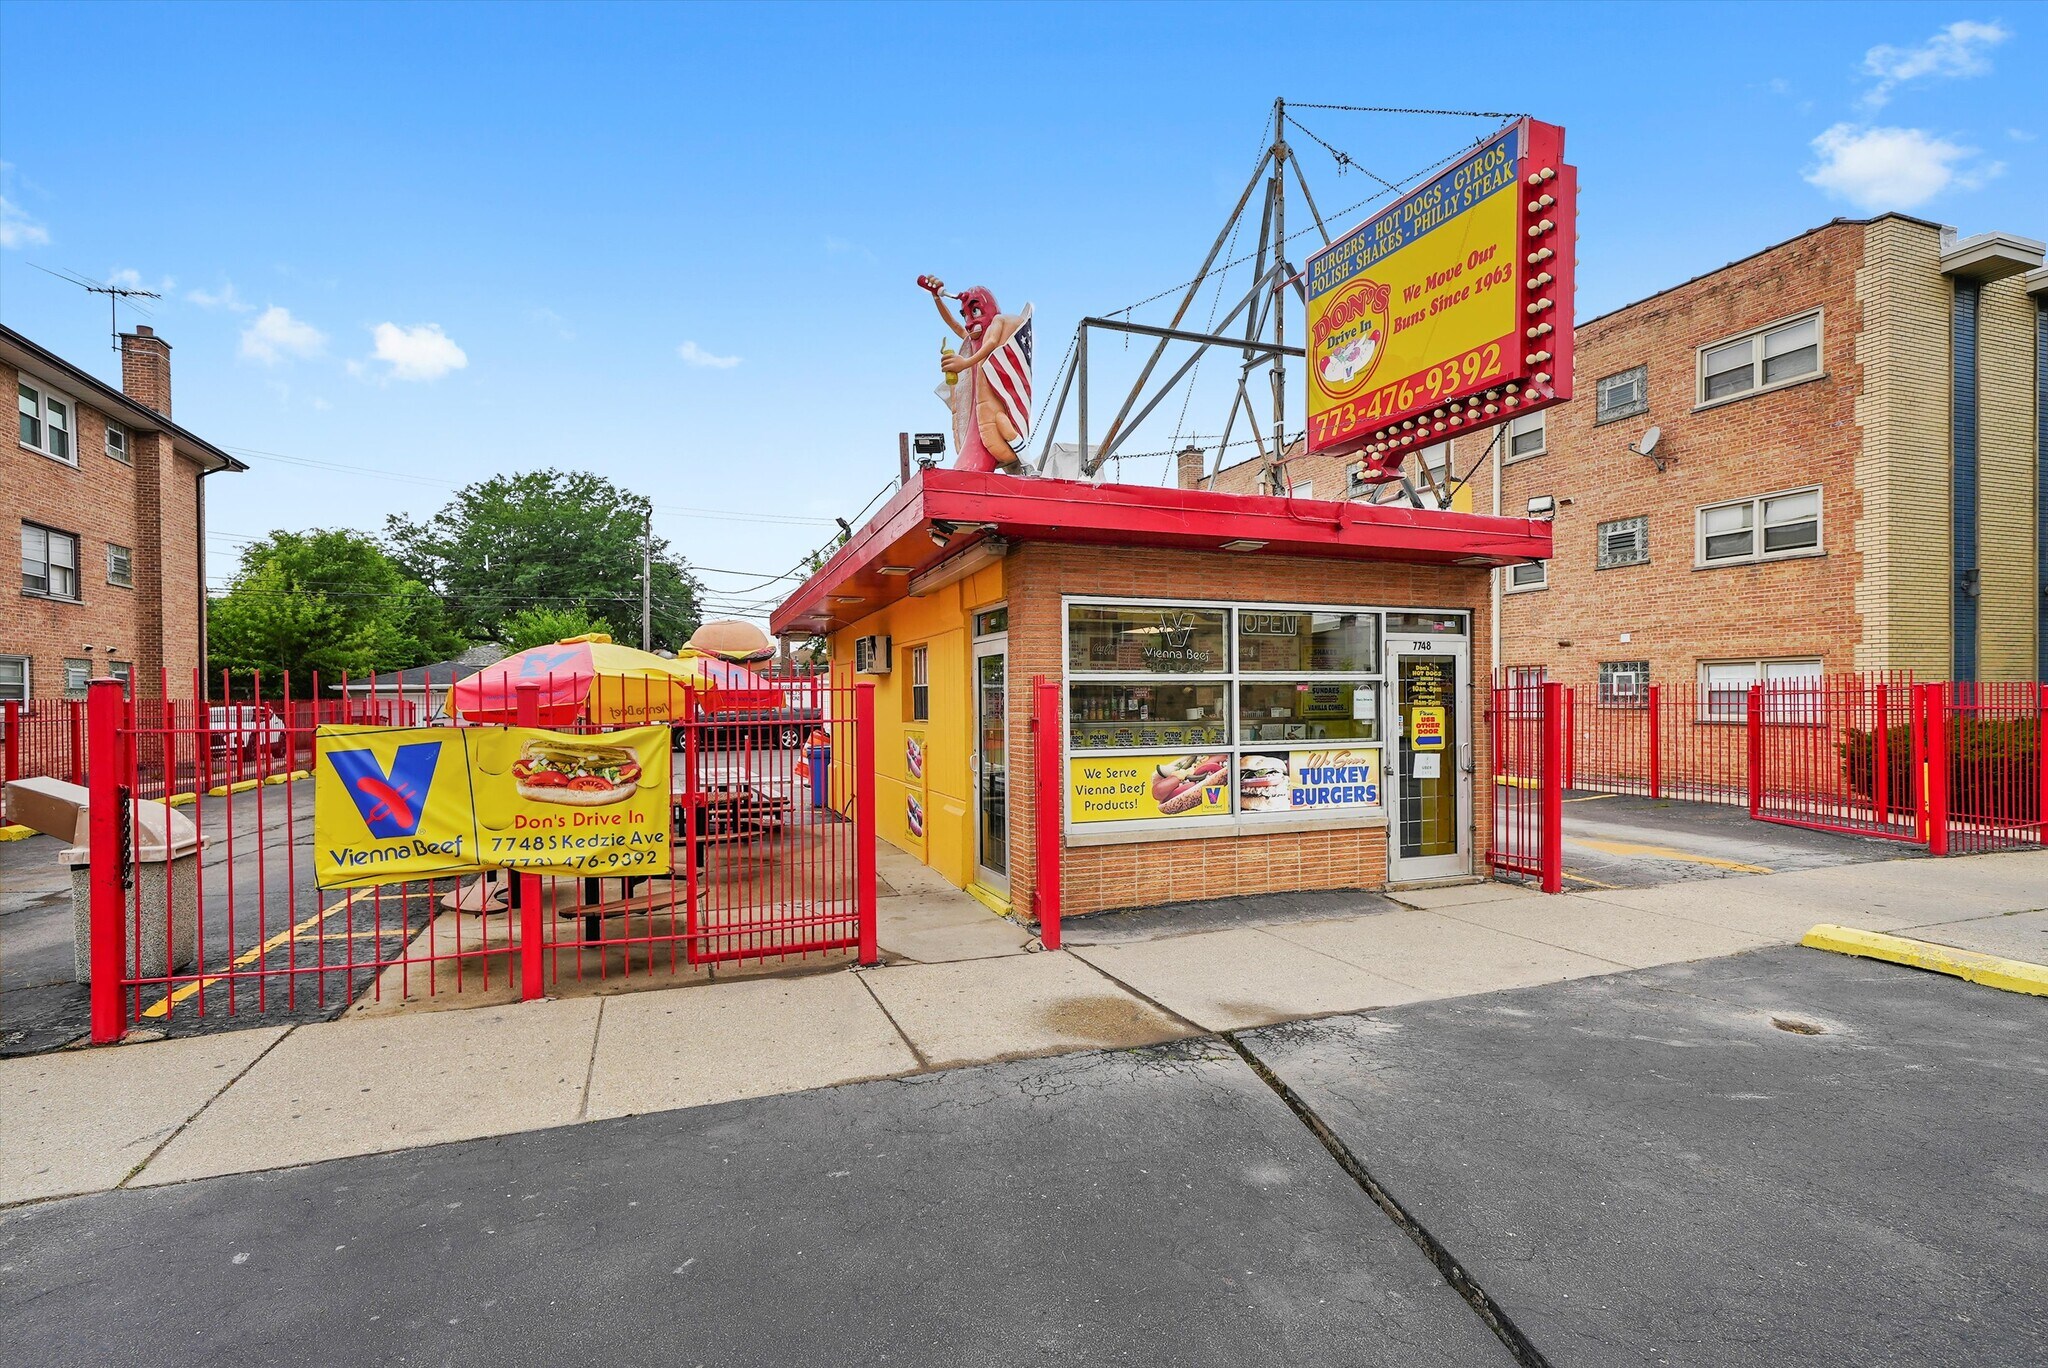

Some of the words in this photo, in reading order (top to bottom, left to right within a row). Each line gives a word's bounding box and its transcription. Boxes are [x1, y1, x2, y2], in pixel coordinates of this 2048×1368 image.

[1314, 233, 1365, 278] BURGERS
[1375, 210, 1401, 241] HOT
[1404, 184, 1442, 222] DOGS
[1454, 143, 1505, 191] GYROS
[1356, 229, 1403, 271] SHAKES
[1413, 194, 1460, 236] PHILLY
[1464, 159, 1514, 206] STEAK
[1403, 284, 1421, 304] We
[1425, 262, 1463, 293] Move
[1467, 244, 1497, 270] Our
[1393, 308, 1426, 334] Buns
[1430, 286, 1470, 316] Since
[1475, 262, 1512, 294] 1963
[1312, 284, 1391, 347] DON'S
[1327, 327, 1357, 350] Drive
[1360, 320, 1372, 334] In
[1316, 343, 1501, 442] 773-476-9392
[1245, 614, 1294, 633] OPEN
[1144, 647, 1182, 660] Vienna
[1186, 649, 1209, 662] Beef
[1413, 641, 1431, 650] 7748
[1307, 751, 1331, 768] We
[1084, 769, 1102, 779] We
[1106, 768, 1137, 778] Serve
[1299, 766, 1370, 785] TURKEY
[1075, 785, 1116, 796] Vienna
[1120, 782, 1146, 796] Beef
[1292, 785, 1377, 806] BURGERS
[1084, 799, 1138, 811] Products!
[514, 814, 566, 829] Don's
[573, 812, 622, 827] Drive
[628, 810, 645, 824] In
[491, 837, 545, 851] 7748
[548, 835, 558, 850] S
[562, 834, 626, 849] Kedzie
[630, 831, 664, 845] Ave
[330, 845, 414, 867] Vienna
[412, 835, 463, 858] Beef
[562, 850, 657, 869] 476-9392
